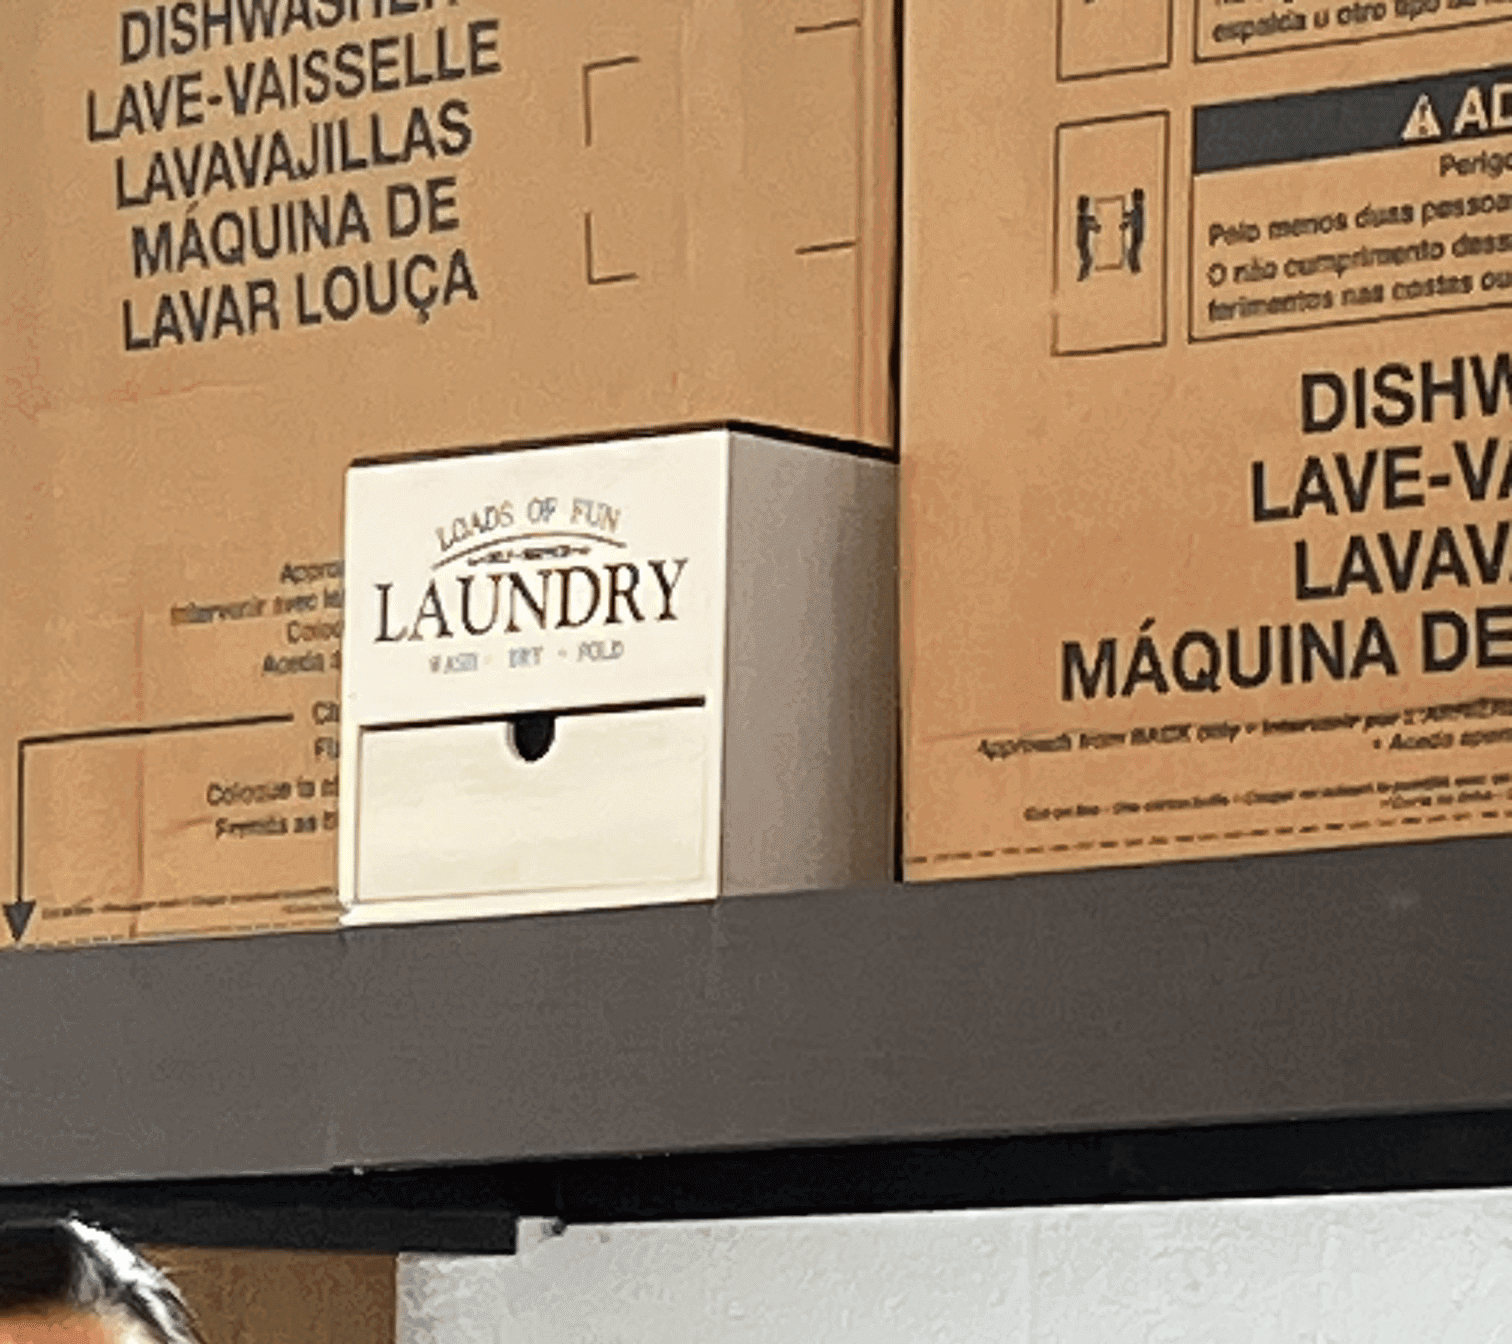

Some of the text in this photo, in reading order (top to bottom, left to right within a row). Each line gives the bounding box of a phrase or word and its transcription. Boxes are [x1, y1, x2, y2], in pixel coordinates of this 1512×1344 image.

[88, 20, 501, 142] LAVE-VAISSELLE
[120, 0, 460, 65] DISHWAS
[116, 100, 473, 208] LAVAVAJILLAS
[132, 176, 460, 279] MÁQUINA DE
[123, 248, 478, 351] LAVAR LOUÇA
[436, 497, 621, 551] LOADS OF FUN
[374, 557, 688, 643] LAUNDRY
[1062, 606, 1512, 702] MÁQUINA DE
